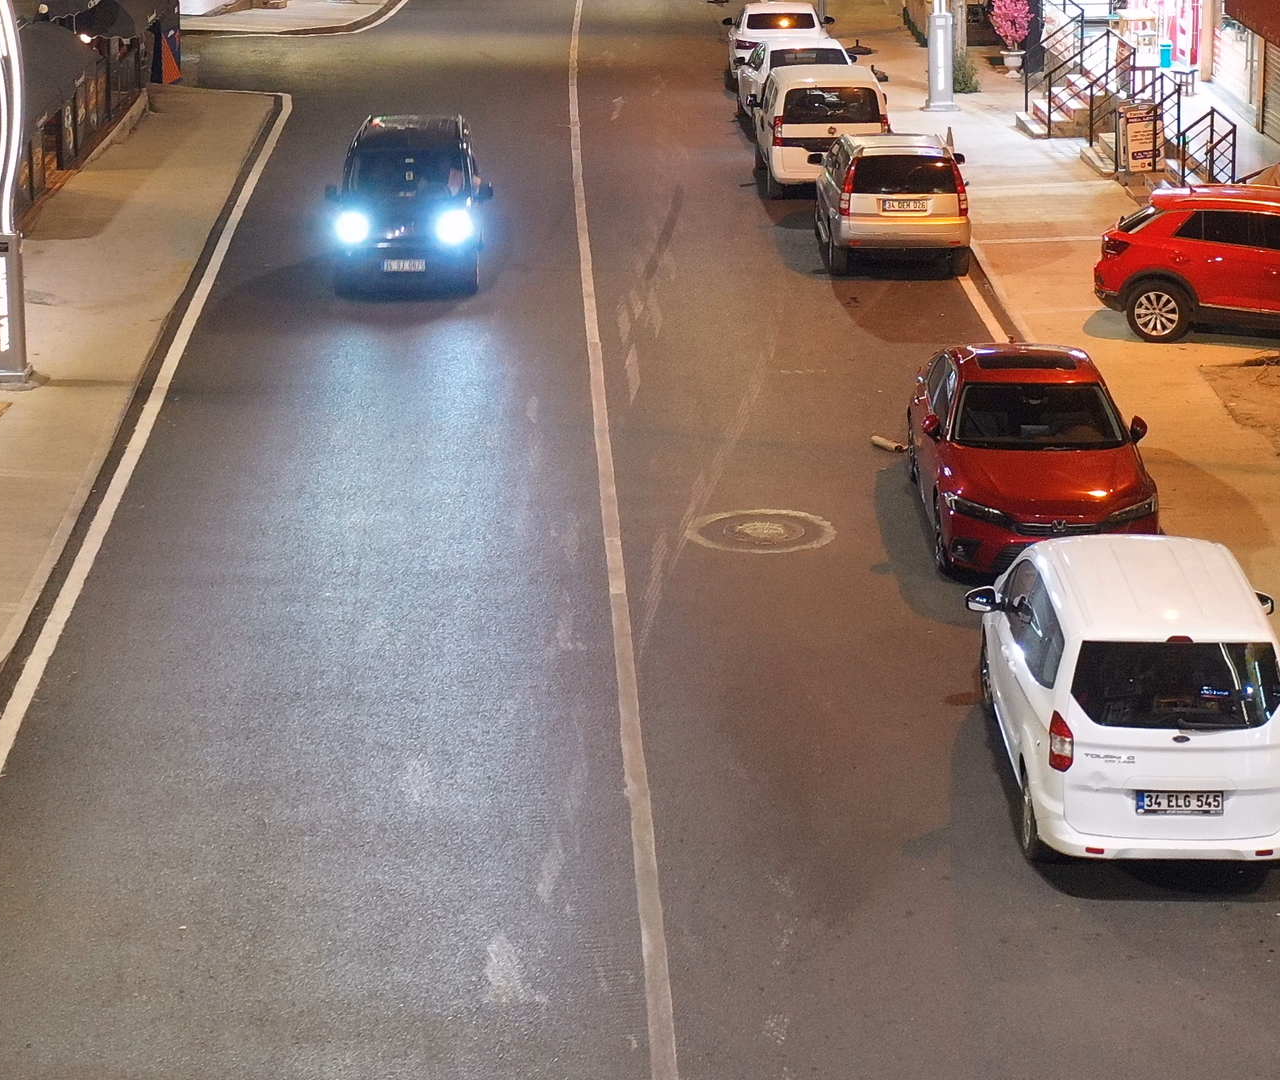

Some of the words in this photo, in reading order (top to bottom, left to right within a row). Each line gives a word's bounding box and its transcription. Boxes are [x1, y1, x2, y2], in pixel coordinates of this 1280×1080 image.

[1084, 753, 1136, 761] TOURNO
[1145, 794, 1162, 809] 34
[1167, 794, 1192, 809] ELG
[1196, 794, 1221, 809] 545
